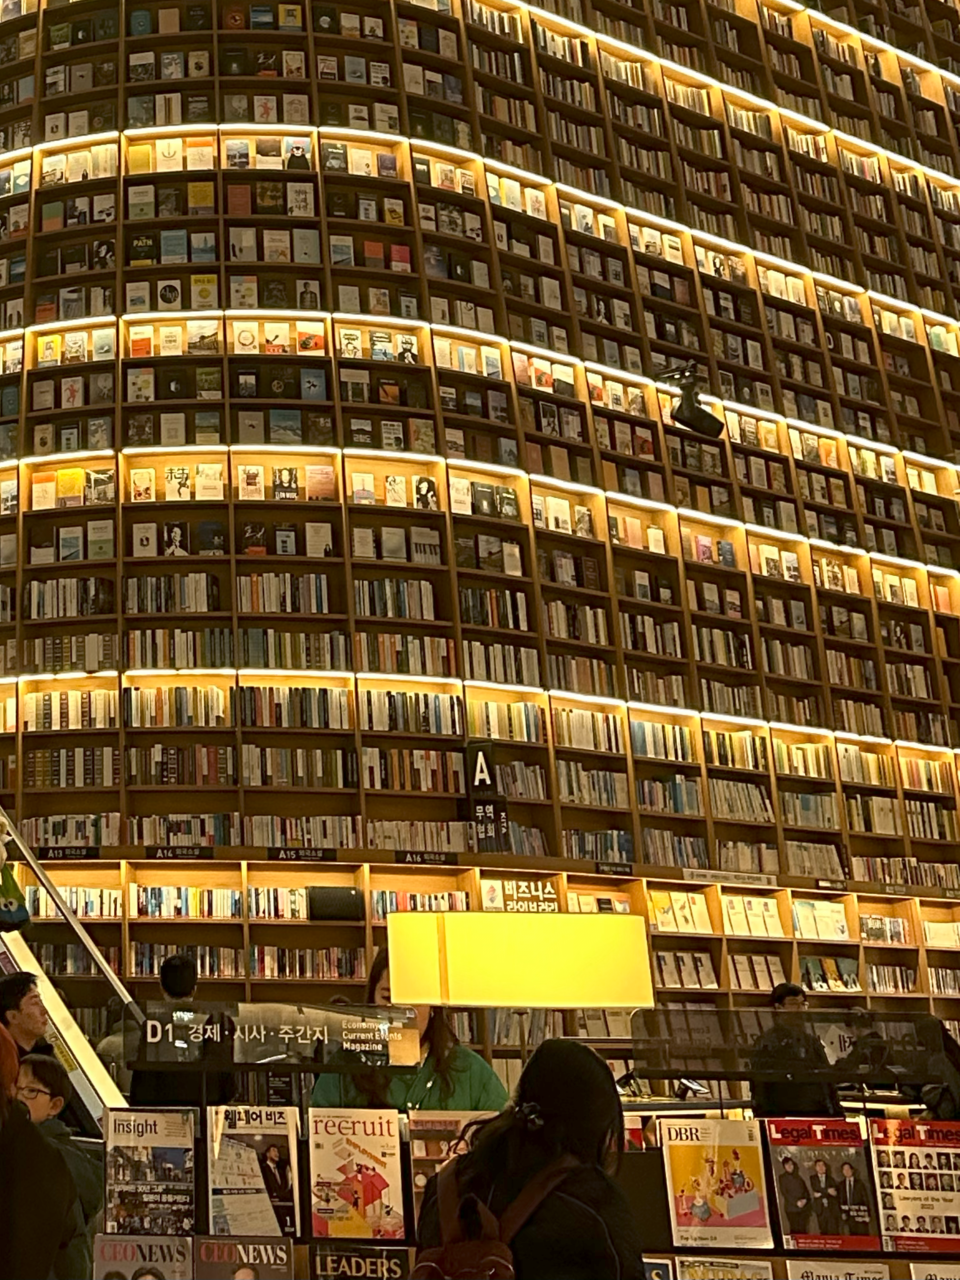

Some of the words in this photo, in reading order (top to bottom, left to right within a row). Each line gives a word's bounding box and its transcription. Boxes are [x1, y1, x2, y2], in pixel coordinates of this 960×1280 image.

[474, 751, 491, 786] A
[48, 848, 63, 858] A13
[156, 849, 173, 858] A14
[279, 850, 296, 859] A15
[405, 853, 421, 863] A16
[504, 880, 557, 900] 비즈니스
[146, 1019, 174, 1043] D1
[342, 1031, 374, 1040] Current
[343, 1041, 383, 1052] Magazine
[265, 1111, 287, 1125] 비즈
[113, 1119, 158, 1137] Insight
[312, 1116, 395, 1137] recruit
[667, 1127, 700, 1142] DBR
[315, 1256, 402, 1278] LEADERS
